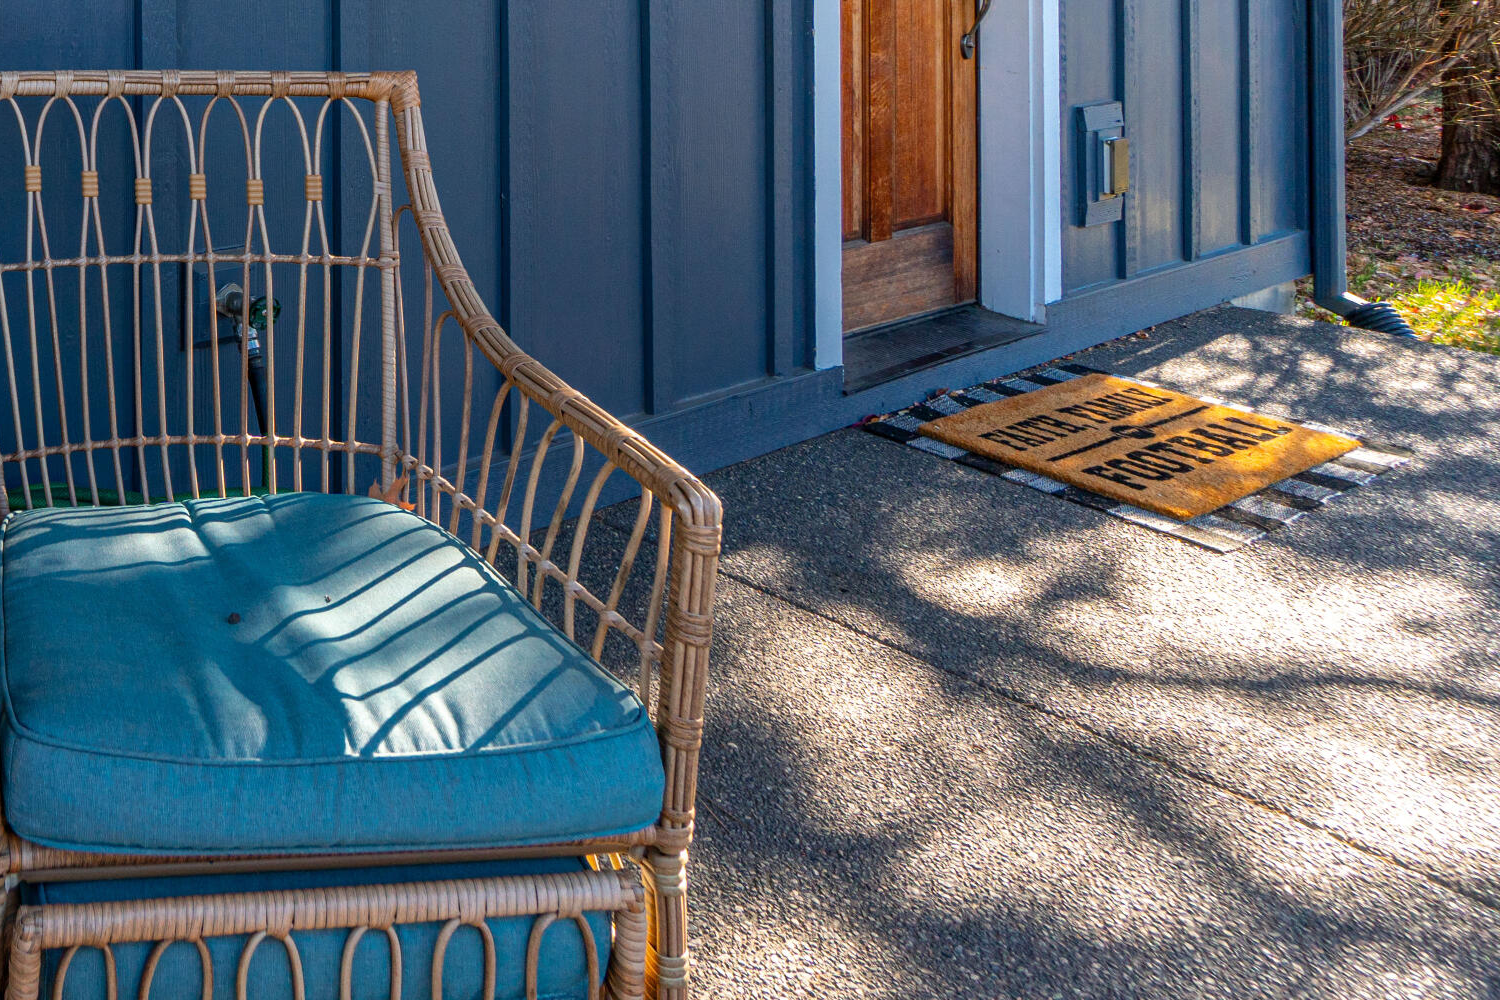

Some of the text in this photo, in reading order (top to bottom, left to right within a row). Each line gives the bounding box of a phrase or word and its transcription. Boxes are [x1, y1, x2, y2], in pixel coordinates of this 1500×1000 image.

[978, 387, 1174, 451] FAITH, FAMILY
[1081, 416, 1293, 491] FOOTBALL
